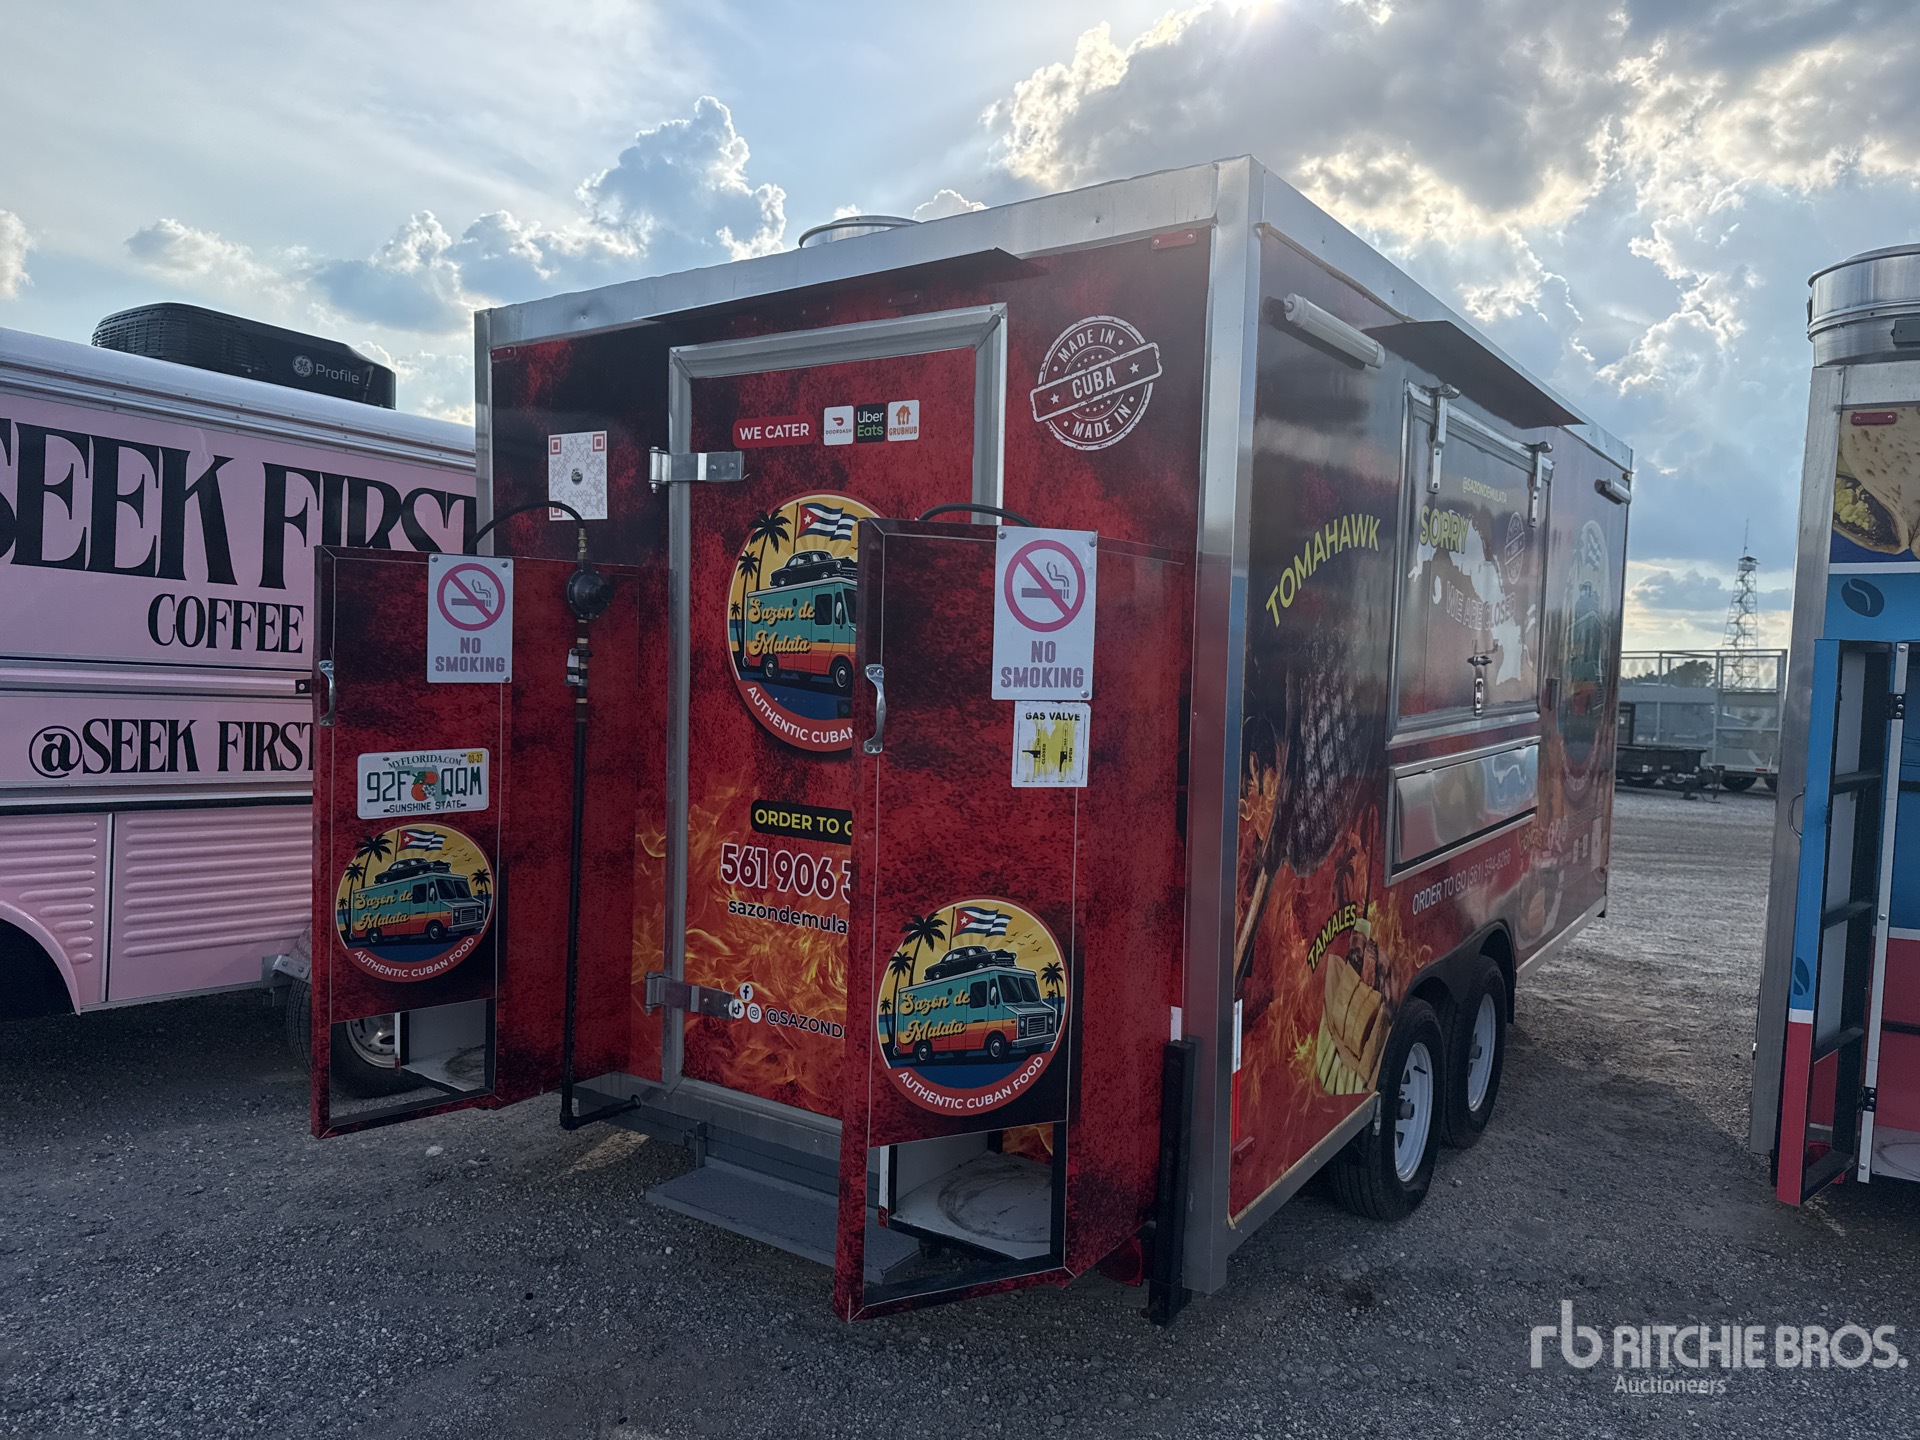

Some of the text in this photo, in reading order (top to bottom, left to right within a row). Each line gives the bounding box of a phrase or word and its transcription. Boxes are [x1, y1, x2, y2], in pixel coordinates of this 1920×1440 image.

[1057, 327, 1116, 363] MADE IN
[315, 363, 360, 385] Profile
[1071, 366, 1117, 399] CUBA
[857, 410, 884, 424] Uber
[857, 424, 884, 437] Eats
[888, 425, 918, 436] GRUBHUB
[1072, 403, 1132, 439] MADE IN
[739, 422, 810, 440] WE CATER
[0, 417, 477, 590] EEK FIRS
[1419, 505, 1470, 554] SORRY
[1265, 513, 1381, 628] TOMAHAWK
[798, 601, 816, 619] de
[1446, 580, 1464, 623] WE
[1463, 597, 1483, 631] ARE
[147, 593, 304, 654] COFFEE
[460, 637, 481, 654] NO
[748, 630, 811, 656] Mulata
[1030, 640, 1057, 663] NO
[435, 656, 505, 673] SMOKING
[1000, 666, 1084, 688] SMOKING
[747, 686, 809, 741] AUTHENTIC
[1025, 712, 1081, 722] GAS VALVE
[28, 718, 200, 779] @SEEK
[388, 753, 462, 770] MYFLORIDA.COM
[366, 765, 482, 803] 92F QQM
[388, 799, 462, 814] SUNSHINE STATE
[754, 808, 812, 831] ORDER
[816, 815, 840, 834] TO
[720, 842, 769, 889] 561
[773, 849, 837, 901] 906
[398, 889, 414, 902] de
[1412, 881, 1442, 915] ORDER
[1443, 876, 1455, 899] TO
[1454, 869, 1467, 892] GO
[354, 912, 409, 931] Mulata
[728, 900, 850, 936] sazondemula
[1307, 903, 1357, 971] TAMALES
[354, 937, 475, 978] AUTHENTIC CUBAN FOOD
[953, 989, 971, 1005] de
[765, 1007, 847, 1040] @SAZOND
[899, 1018, 967, 1045] Mulata
[898, 1056, 1044, 1109] AUTHENTIC CUBAN FOOD
